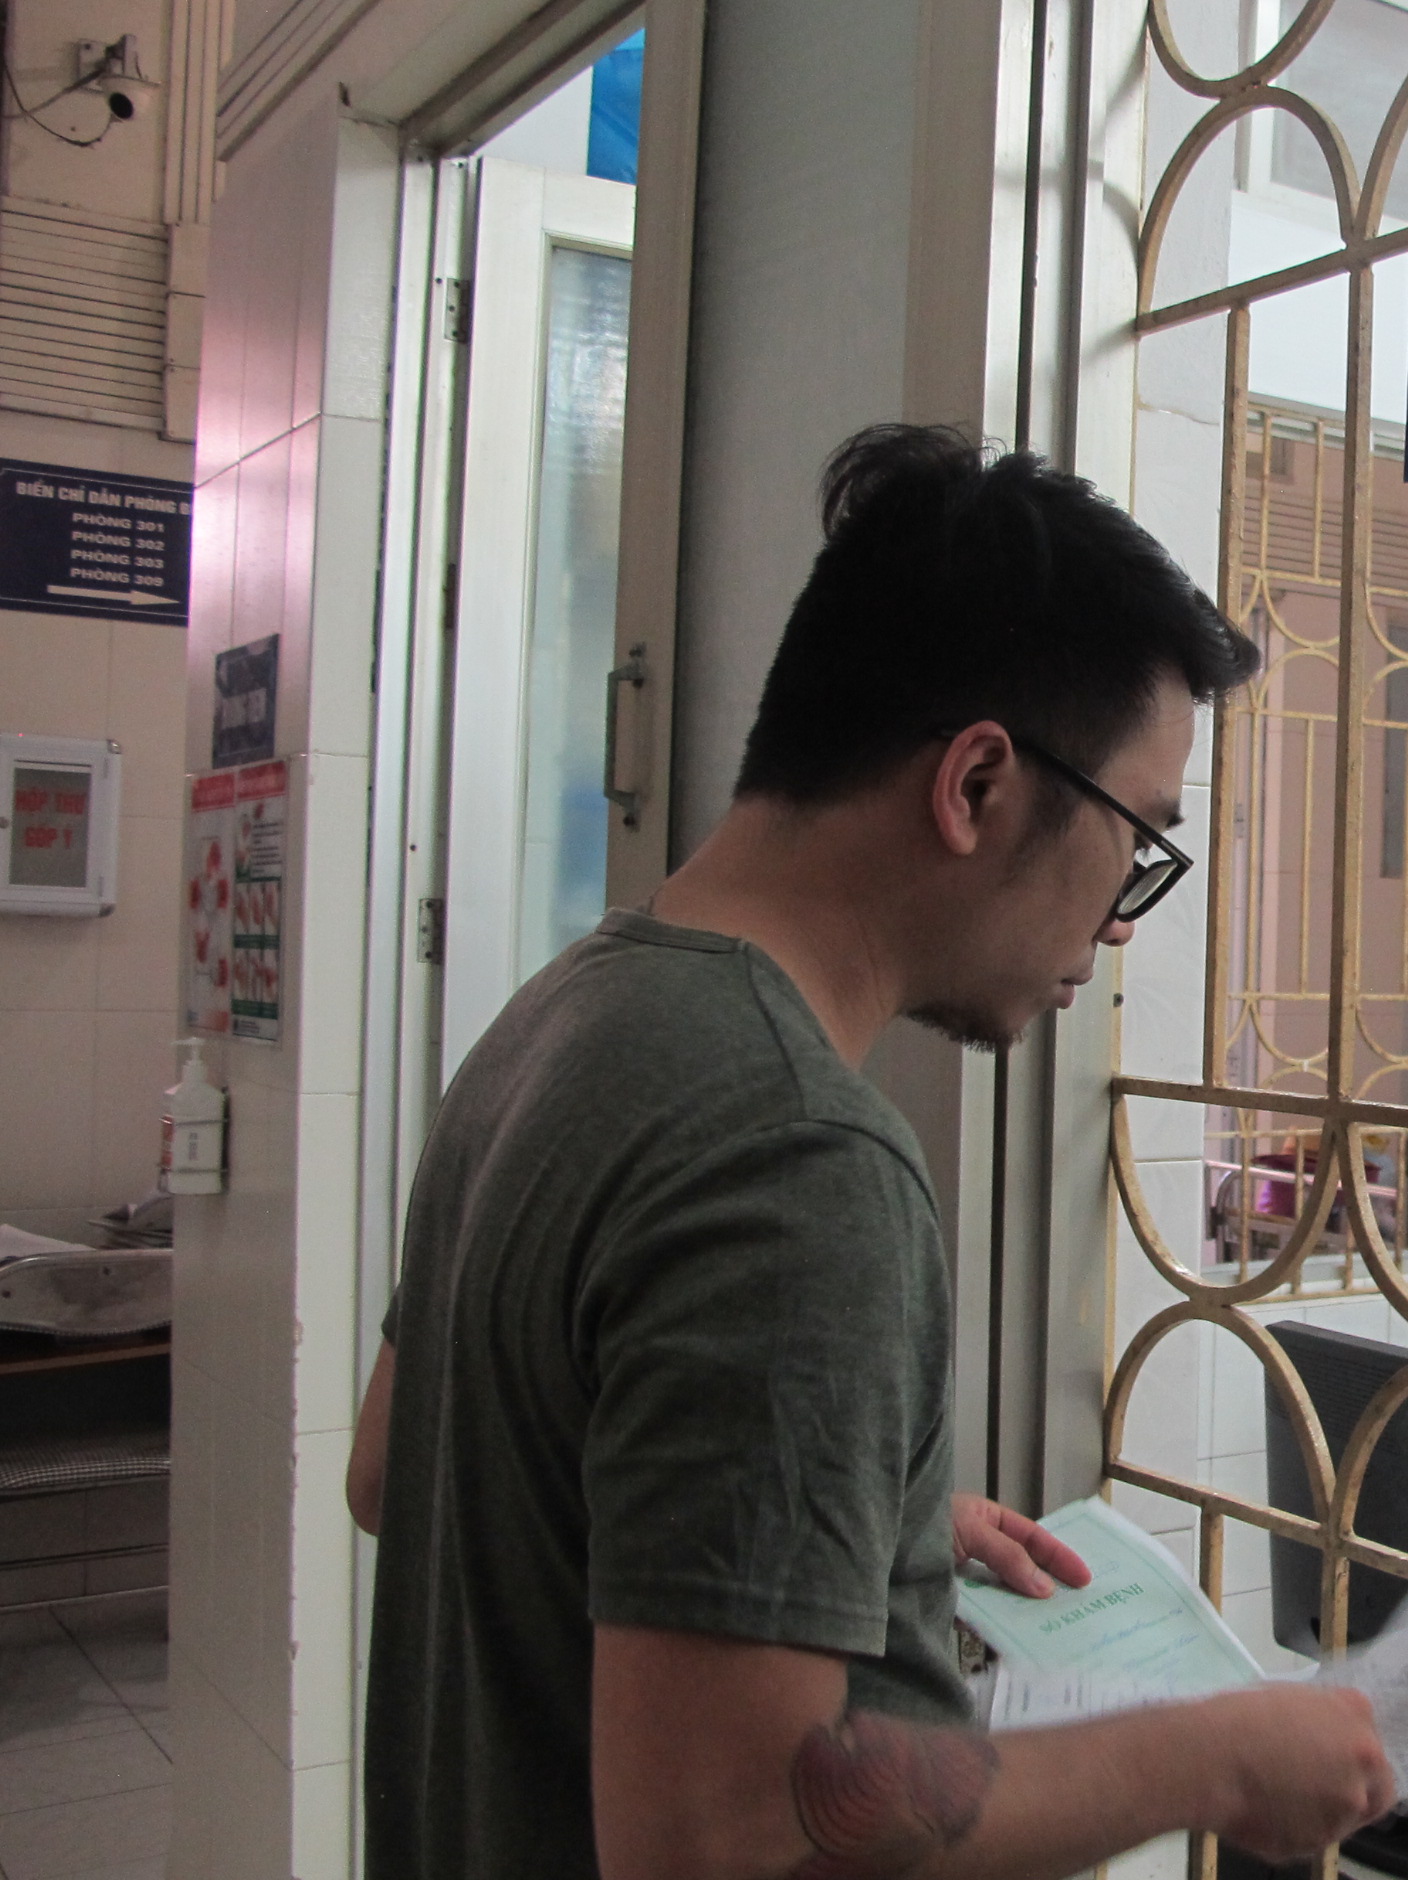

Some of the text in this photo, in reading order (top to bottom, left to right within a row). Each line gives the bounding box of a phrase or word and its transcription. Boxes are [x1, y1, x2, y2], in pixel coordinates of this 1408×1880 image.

[124, 495, 178, 514] PHÒNG
[72, 512, 165, 533] PHÒNG 301
[71, 531, 165, 551] PHÒNG 302
[70, 549, 164, 569] PHÒNG 303
[70, 567, 130, 583] PHÒNG
